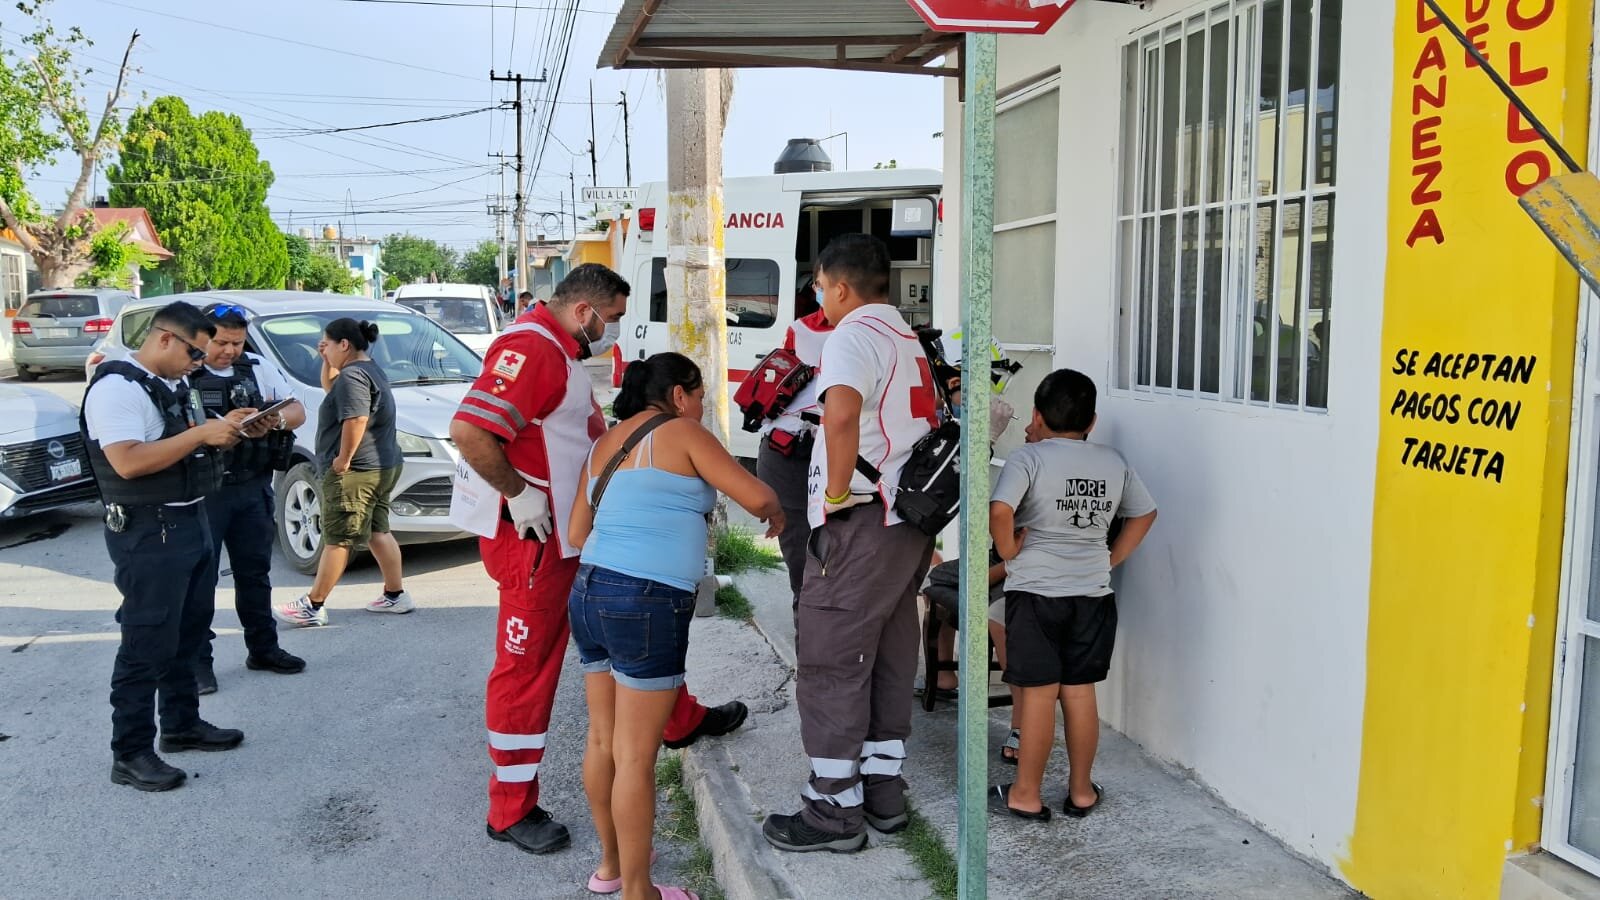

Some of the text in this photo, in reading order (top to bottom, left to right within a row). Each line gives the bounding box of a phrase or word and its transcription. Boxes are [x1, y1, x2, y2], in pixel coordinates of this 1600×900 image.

[586, 190, 613, 199] VILLA
[724, 212, 785, 228] ANCIA
[1392, 349, 1537, 384] SE ACEPTAN
[1390, 389, 1521, 431] PAGOS CON
[1401, 437, 1505, 483] TARJETA
[1065, 479, 1106, 497] MORE
[1056, 499, 1112, 512] THAN A CLUB
